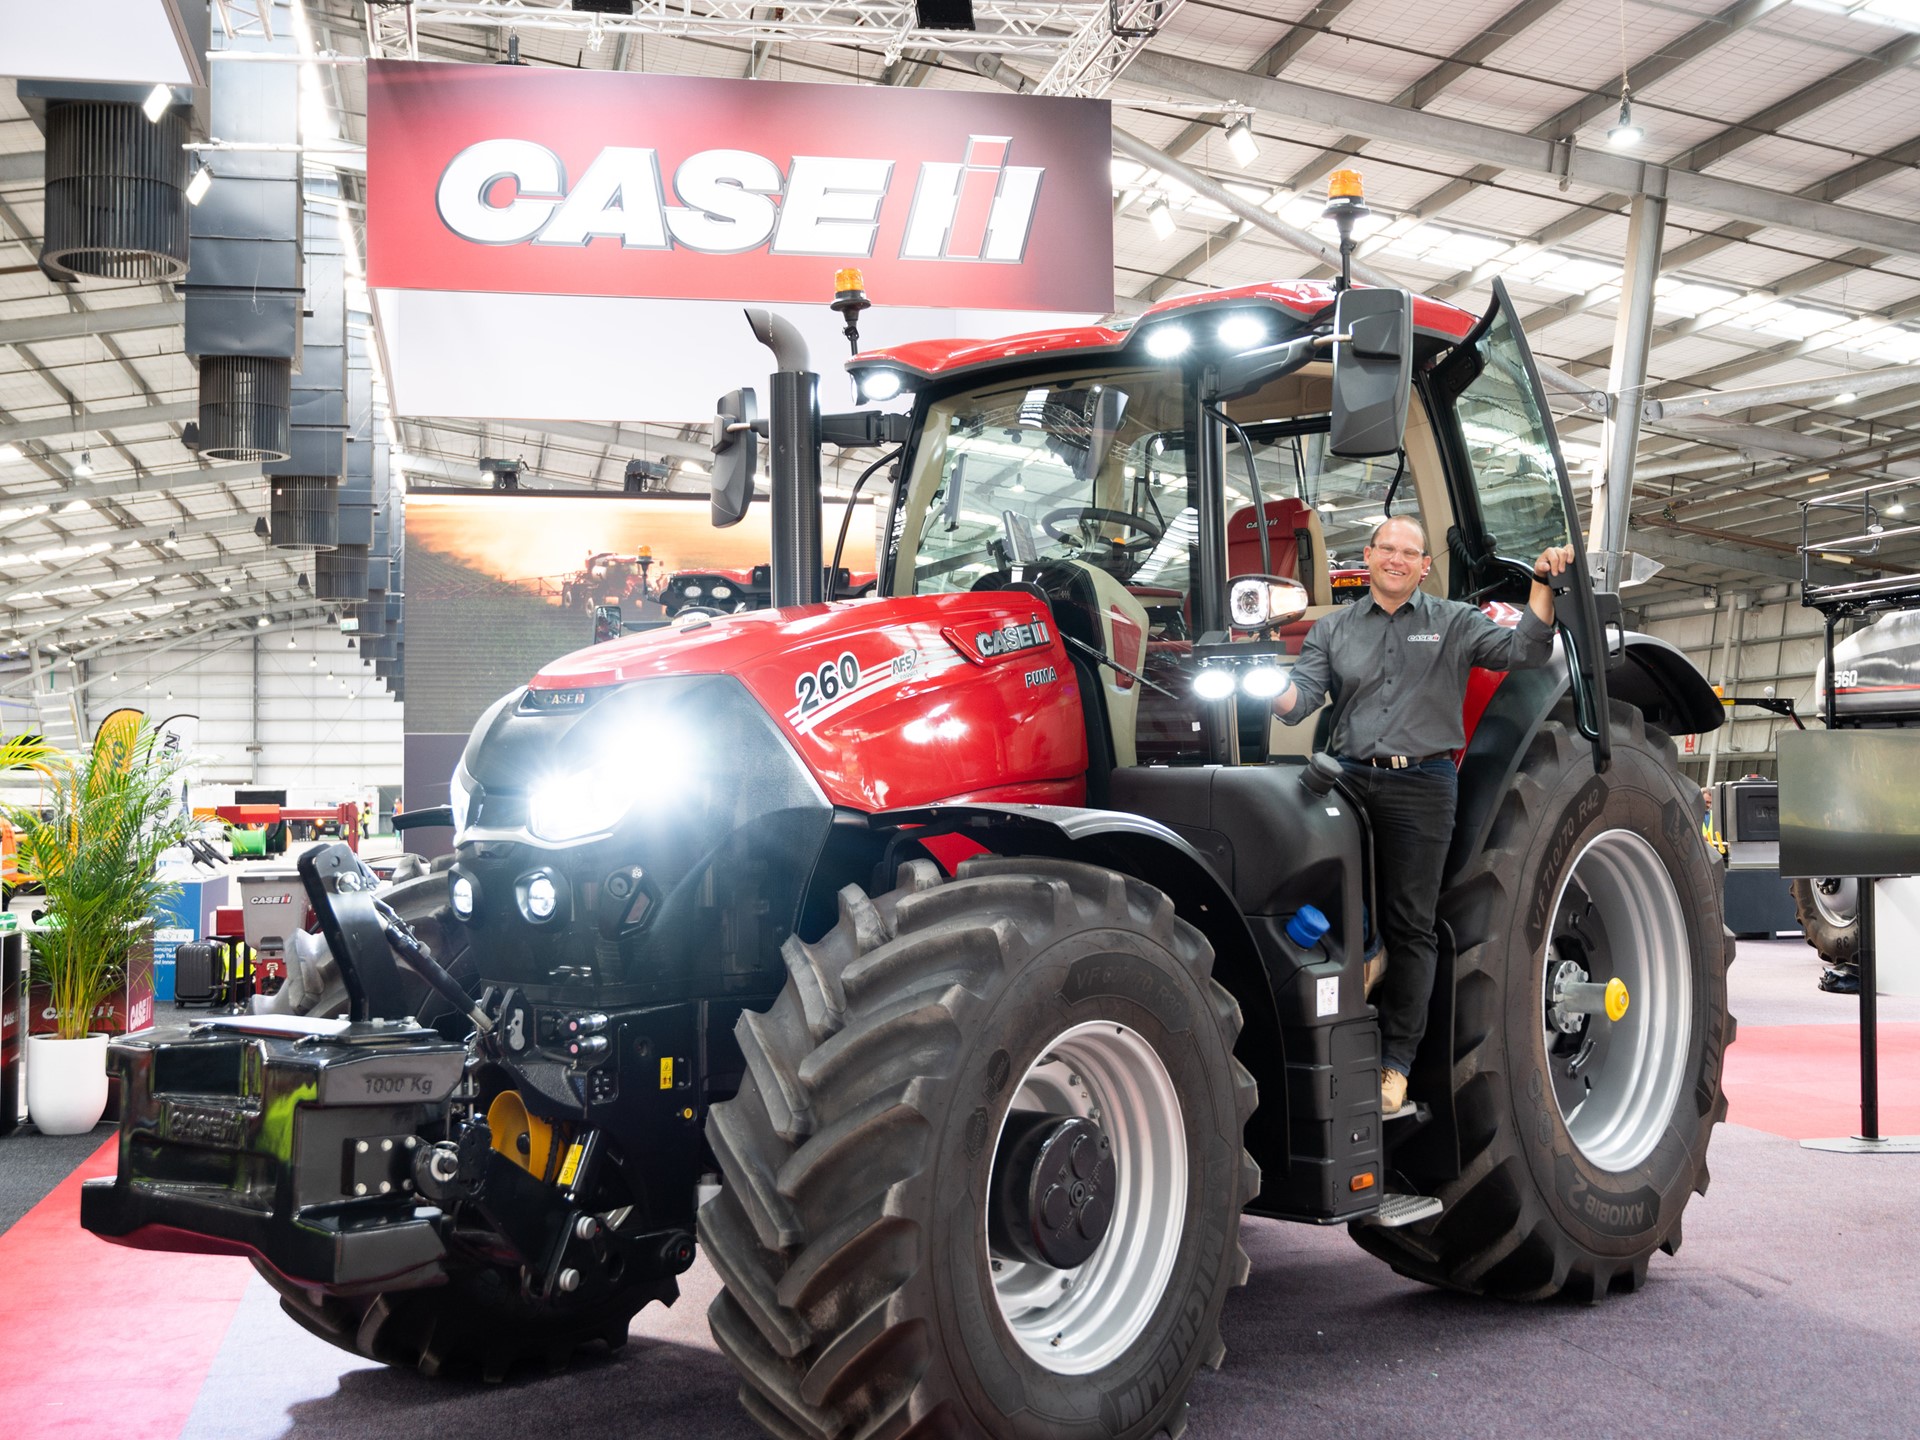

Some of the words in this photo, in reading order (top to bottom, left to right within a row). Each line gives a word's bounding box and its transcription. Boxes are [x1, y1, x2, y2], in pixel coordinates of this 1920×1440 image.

[435, 138, 896, 258] CASE
[892, 653, 914, 675] AFS
[1025, 666, 1057, 688] PUMA
[797, 653, 859, 714] 260
[1578, 788, 1599, 824] R42
[365, 1078, 404, 1094] 1000
[411, 1077, 433, 1095] Kg
[1584, 1193, 1644, 1226] AXIOBIB
[1117, 1221, 1224, 1433] MICHELIN
